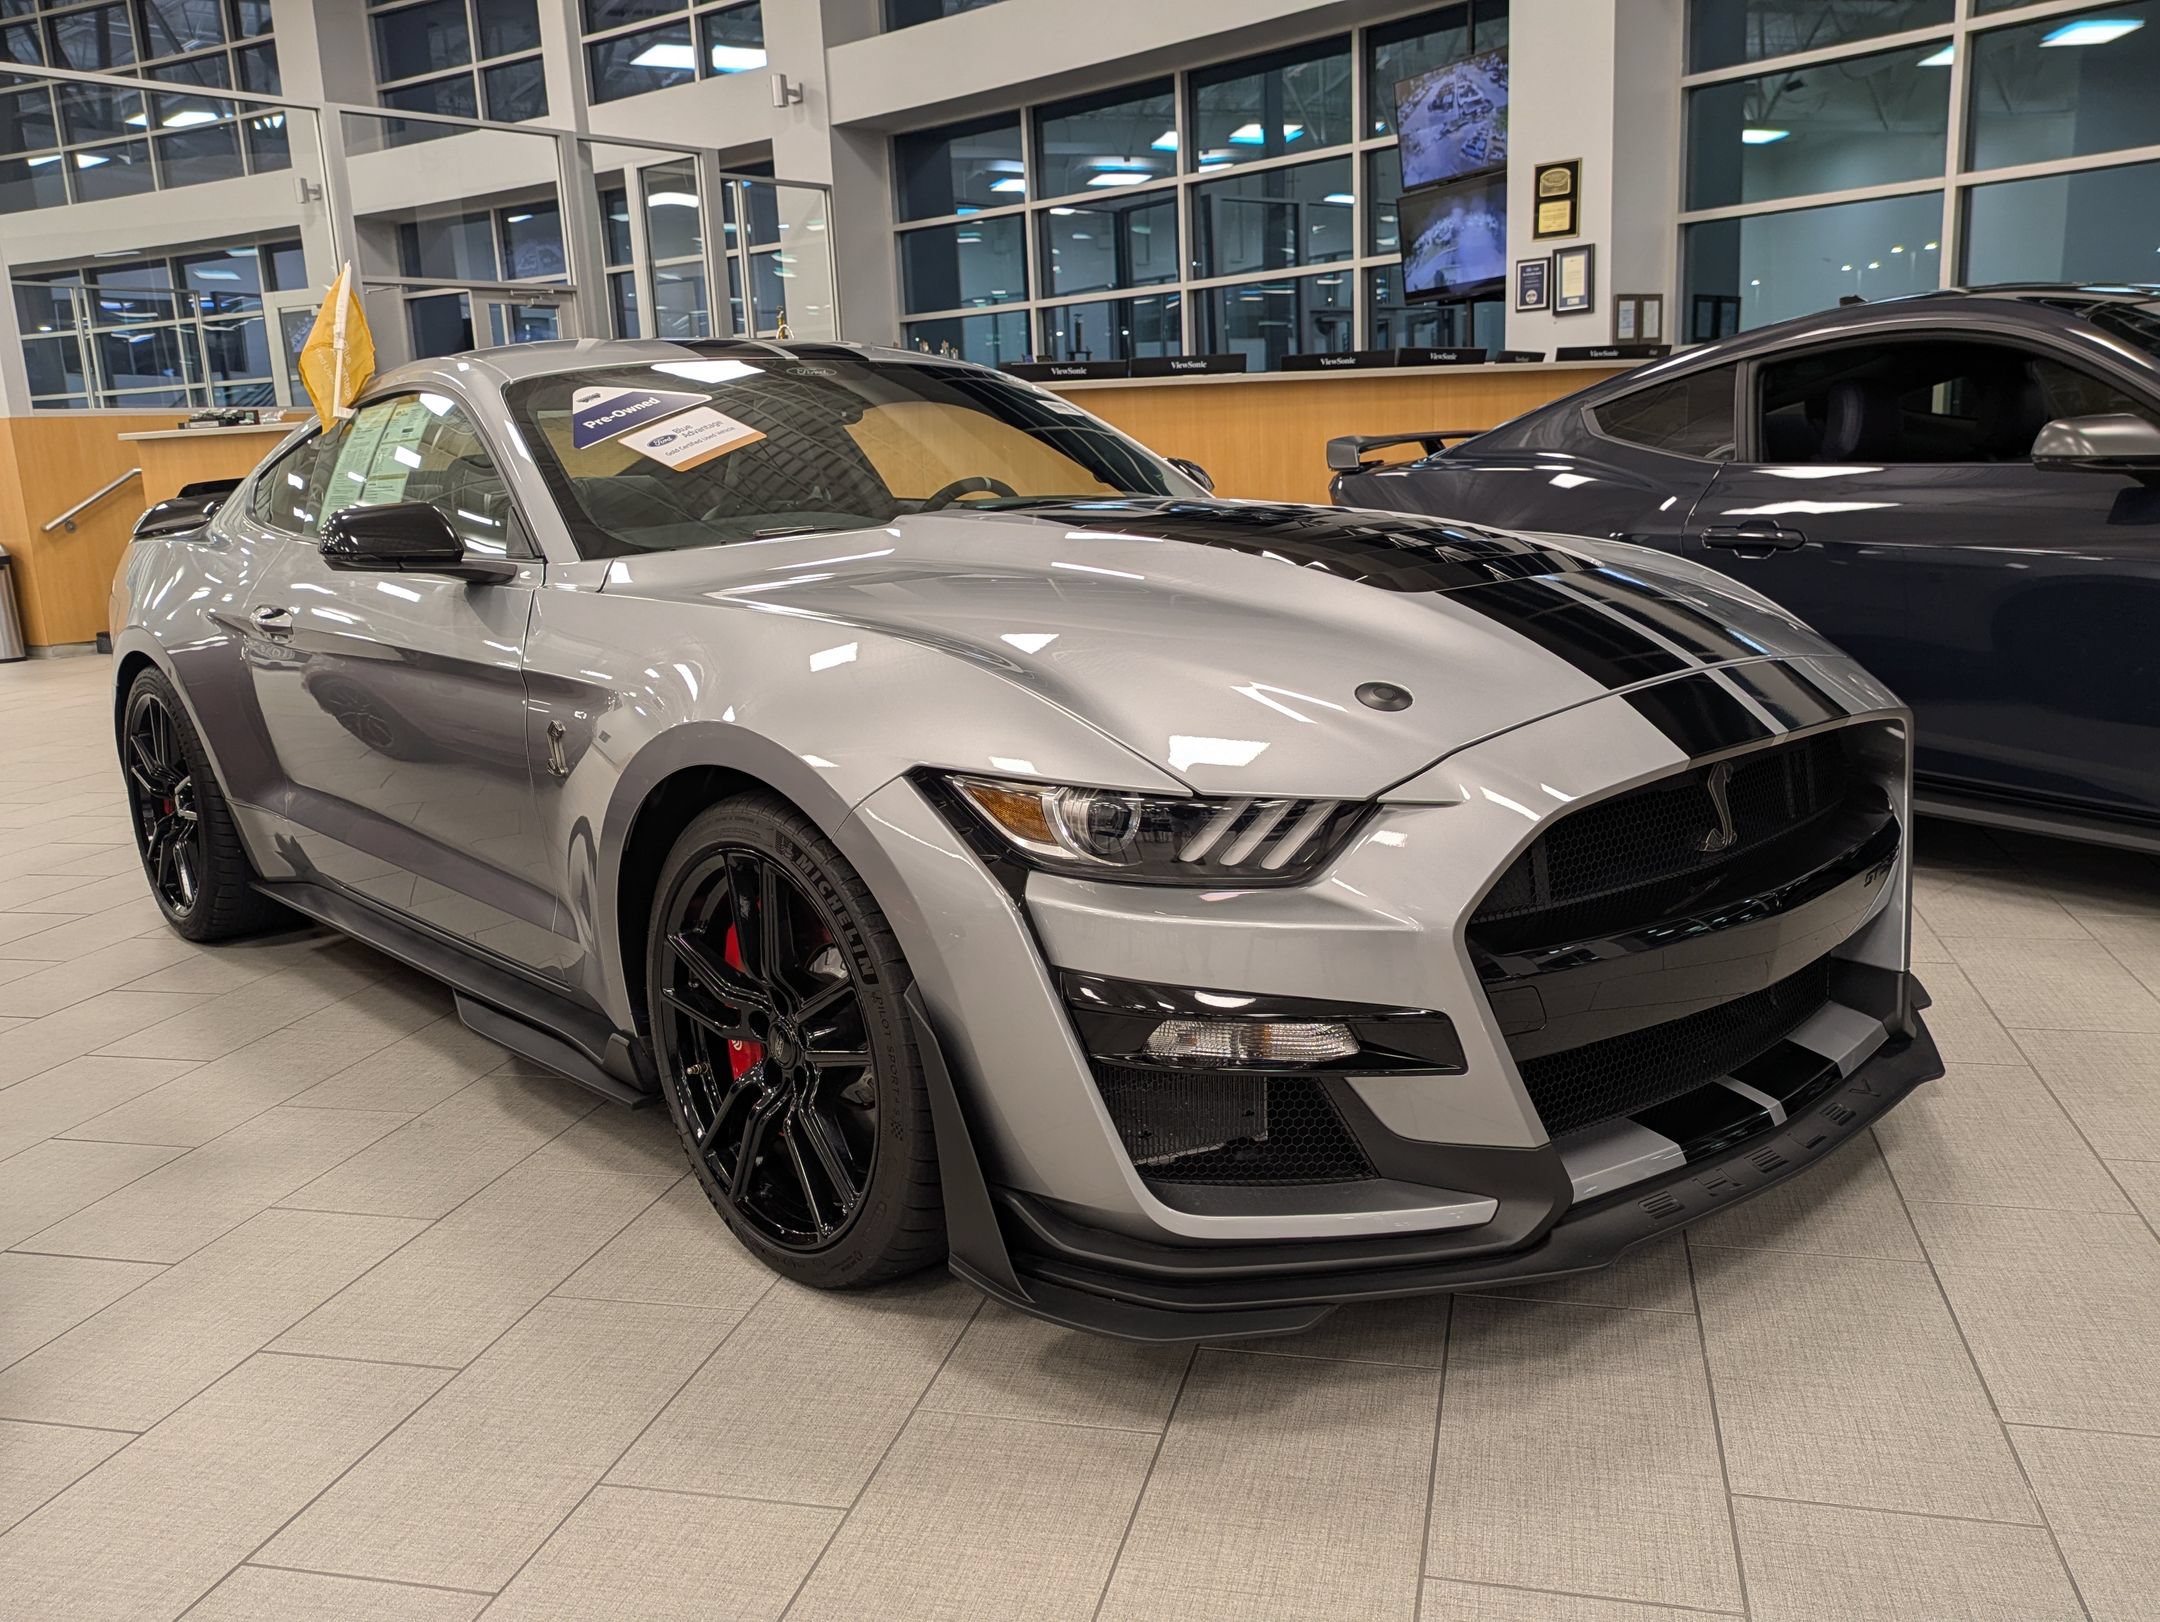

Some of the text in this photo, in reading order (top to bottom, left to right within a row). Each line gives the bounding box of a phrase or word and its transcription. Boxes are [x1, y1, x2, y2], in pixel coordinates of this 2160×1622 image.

[1170, 360, 1207, 370] ViewSonic
[1320, 357, 1356, 366] ViewSonic
[1051, 367, 1087, 376] ViewSonic
[582, 397, 661, 429] Pre-Owned
[672, 424, 693, 434] Blue
[681, 420, 724, 439] Advantage
[665, 447, 679, 457] Gold
[679, 438, 701, 452] Certified
[795, 855, 874, 978] MICHELIN
[875, 996, 892, 1038] PILOT
[886, 1045, 900, 1094] SPORT
[1637, 1078, 1881, 1219] SHELBY
